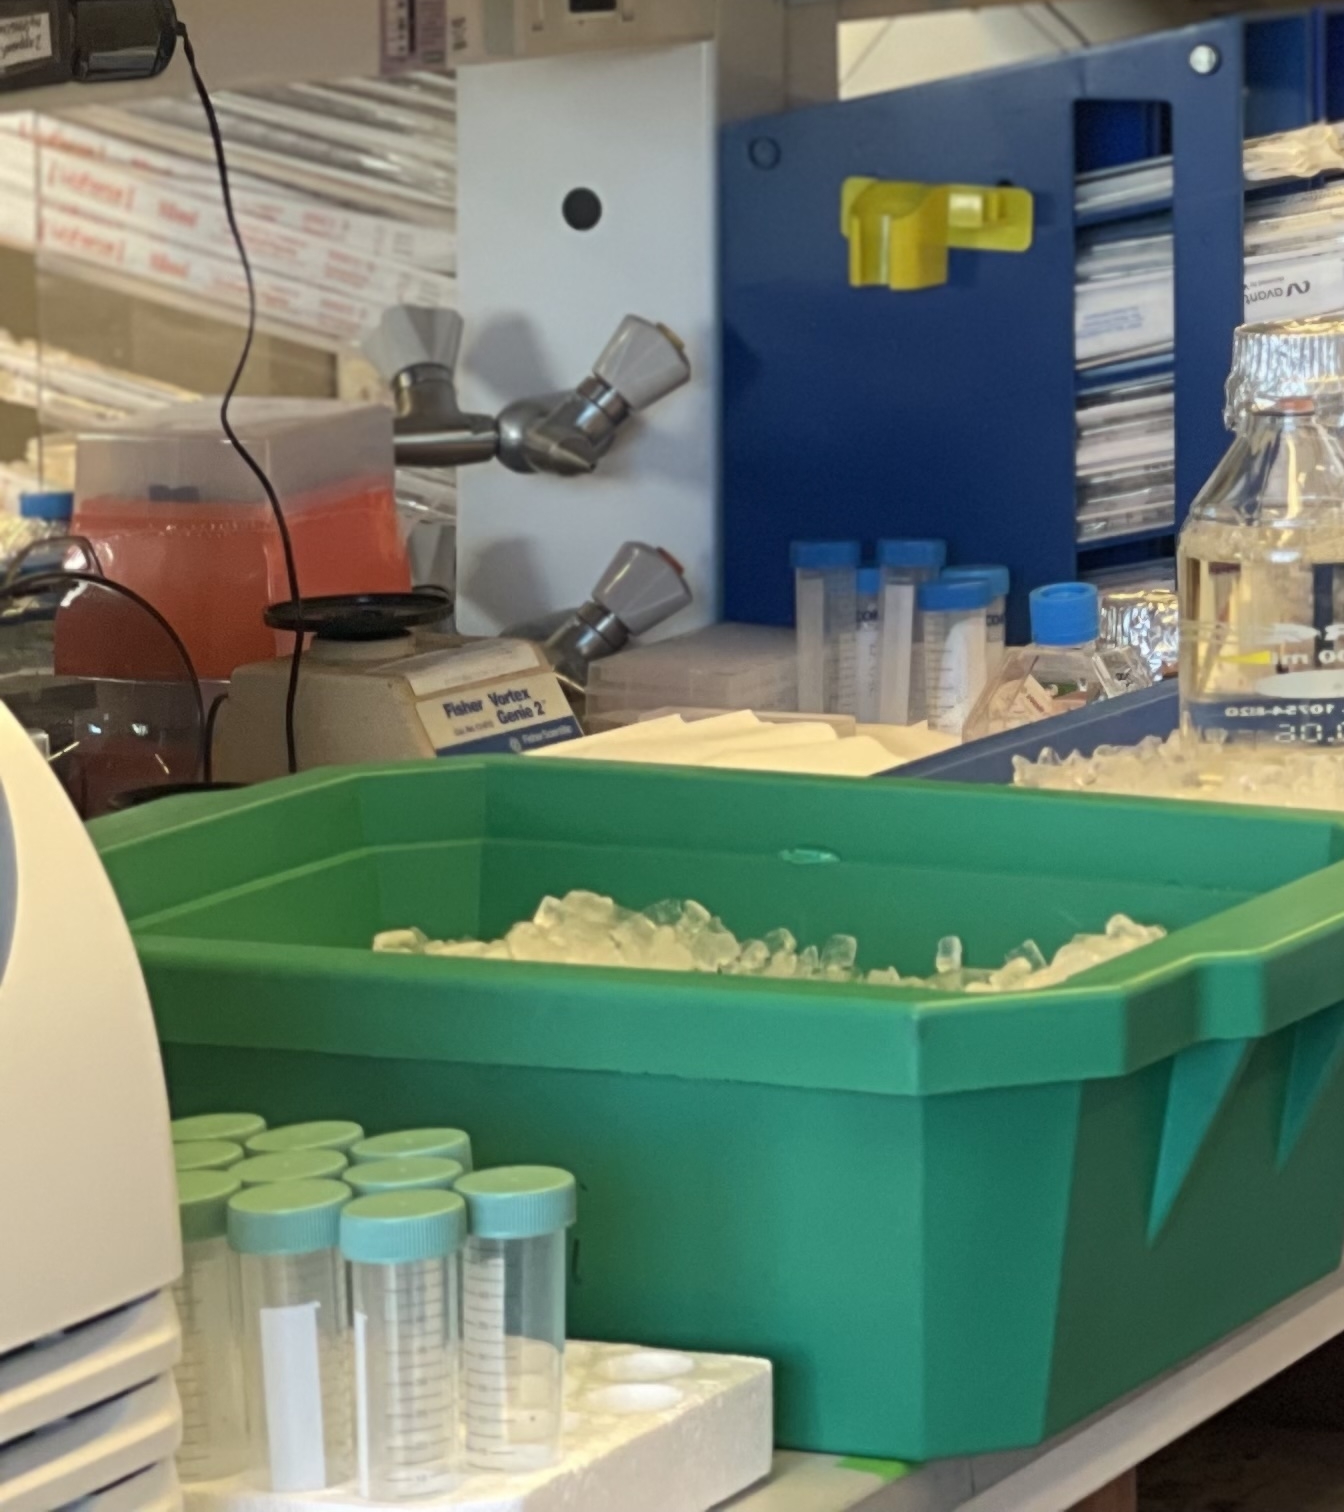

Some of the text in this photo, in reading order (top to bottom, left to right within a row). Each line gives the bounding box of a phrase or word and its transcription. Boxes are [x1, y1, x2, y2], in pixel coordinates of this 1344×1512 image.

[443, 688, 532, 719] Fisher Vortex
[497, 705, 534, 725] Genie
